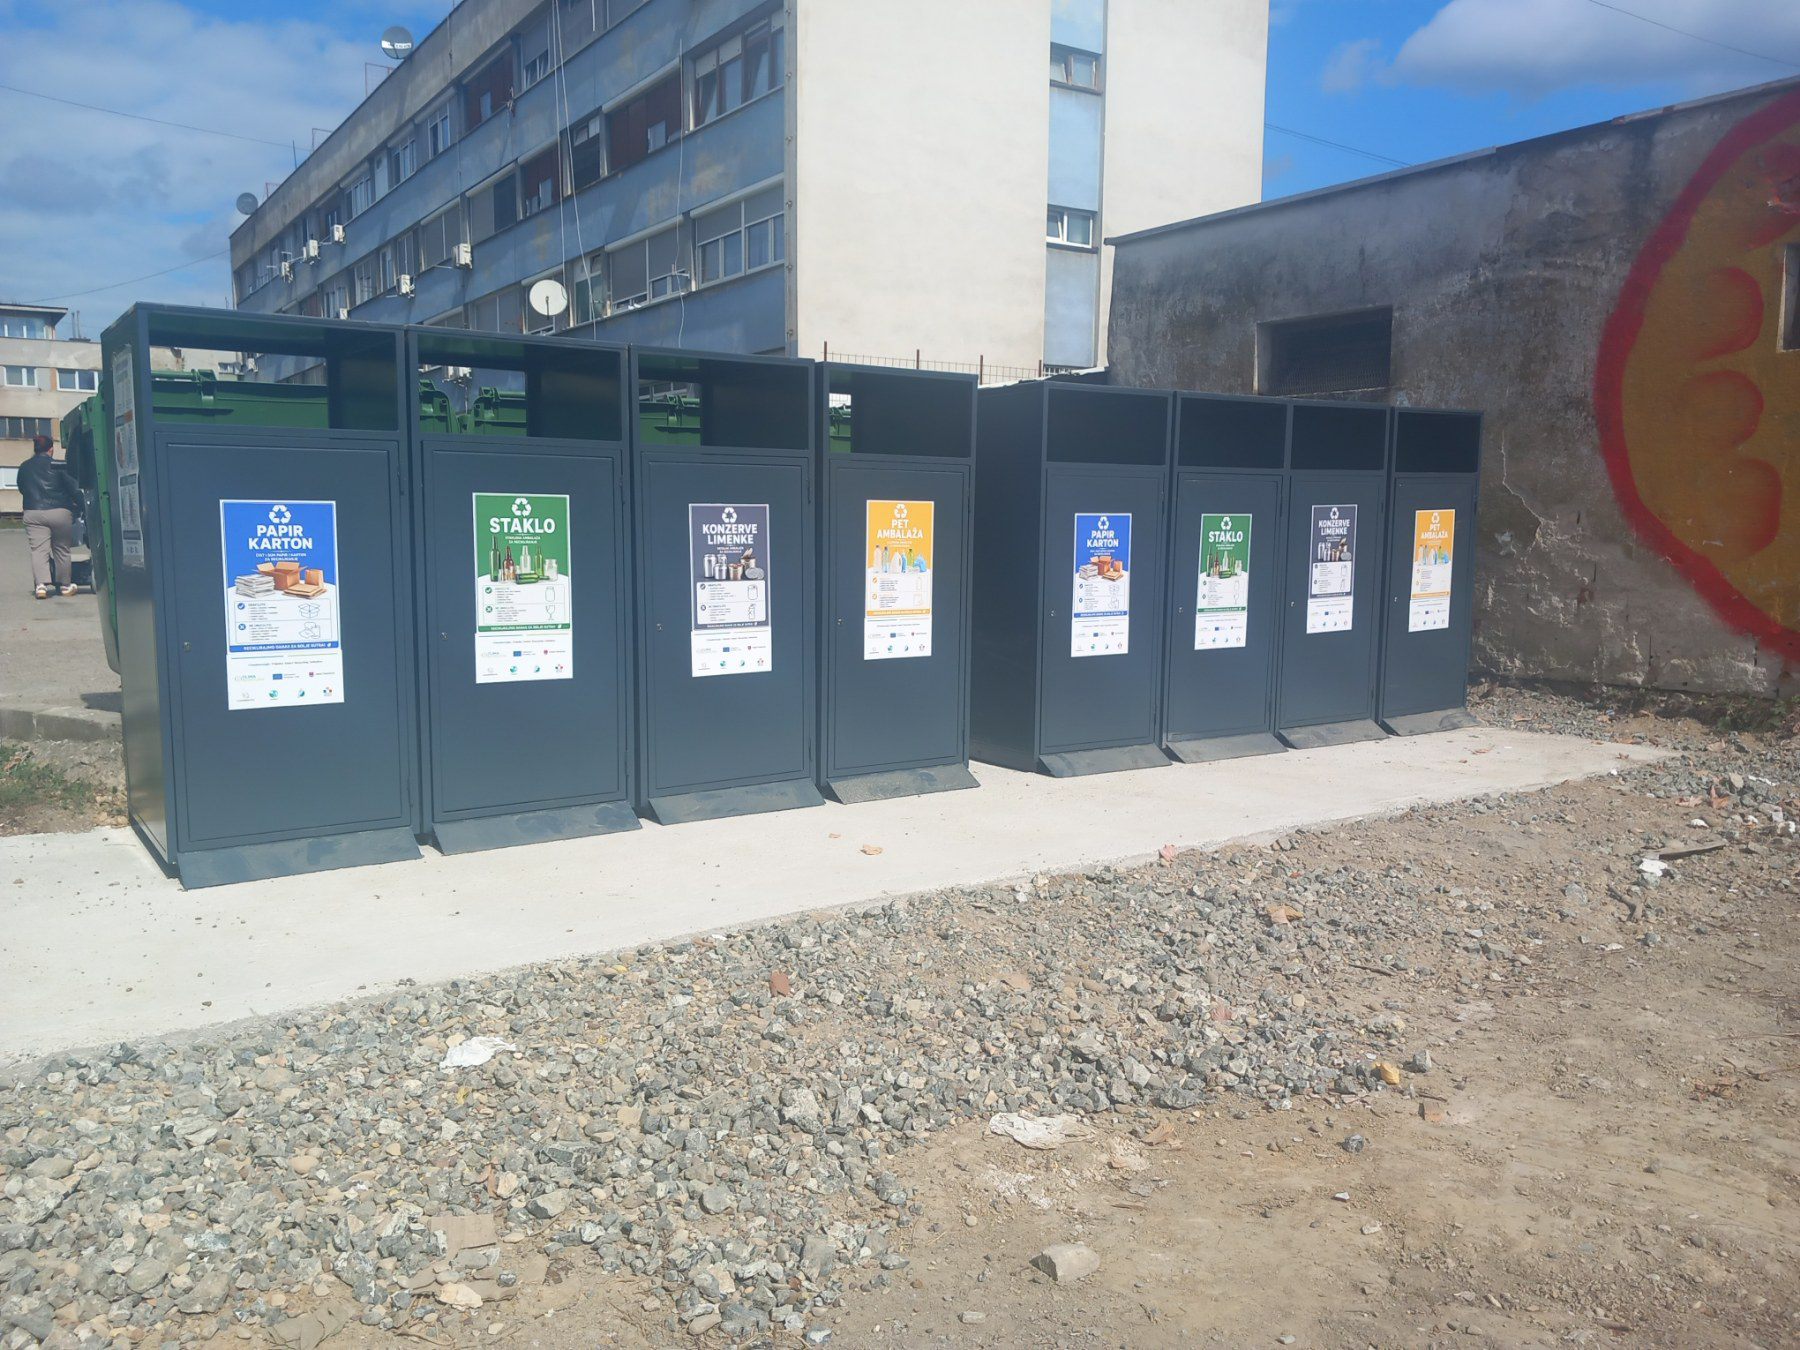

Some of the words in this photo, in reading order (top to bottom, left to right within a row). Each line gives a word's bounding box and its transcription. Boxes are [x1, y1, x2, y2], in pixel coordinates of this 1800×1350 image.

[489, 517, 556, 533] STAKLO
[702, 523, 758, 534] KONZERVE
[891, 519, 909, 529] PET
[1318, 519, 1351, 528] KONZERVE
[1429, 523, 1441, 532] PET
[256, 524, 304, 537] PAPIR
[877, 527, 924, 539] AMBALAŽA
[1091, 530, 1115, 539] PAPIR
[1320, 527, 1348, 536] LIMENKE
[707, 534, 754, 545] LIMENKE
[1208, 530, 1244, 543] STAKLO
[248, 537, 313, 550] KARTON
[1086, 539, 1119, 548] KARTON
